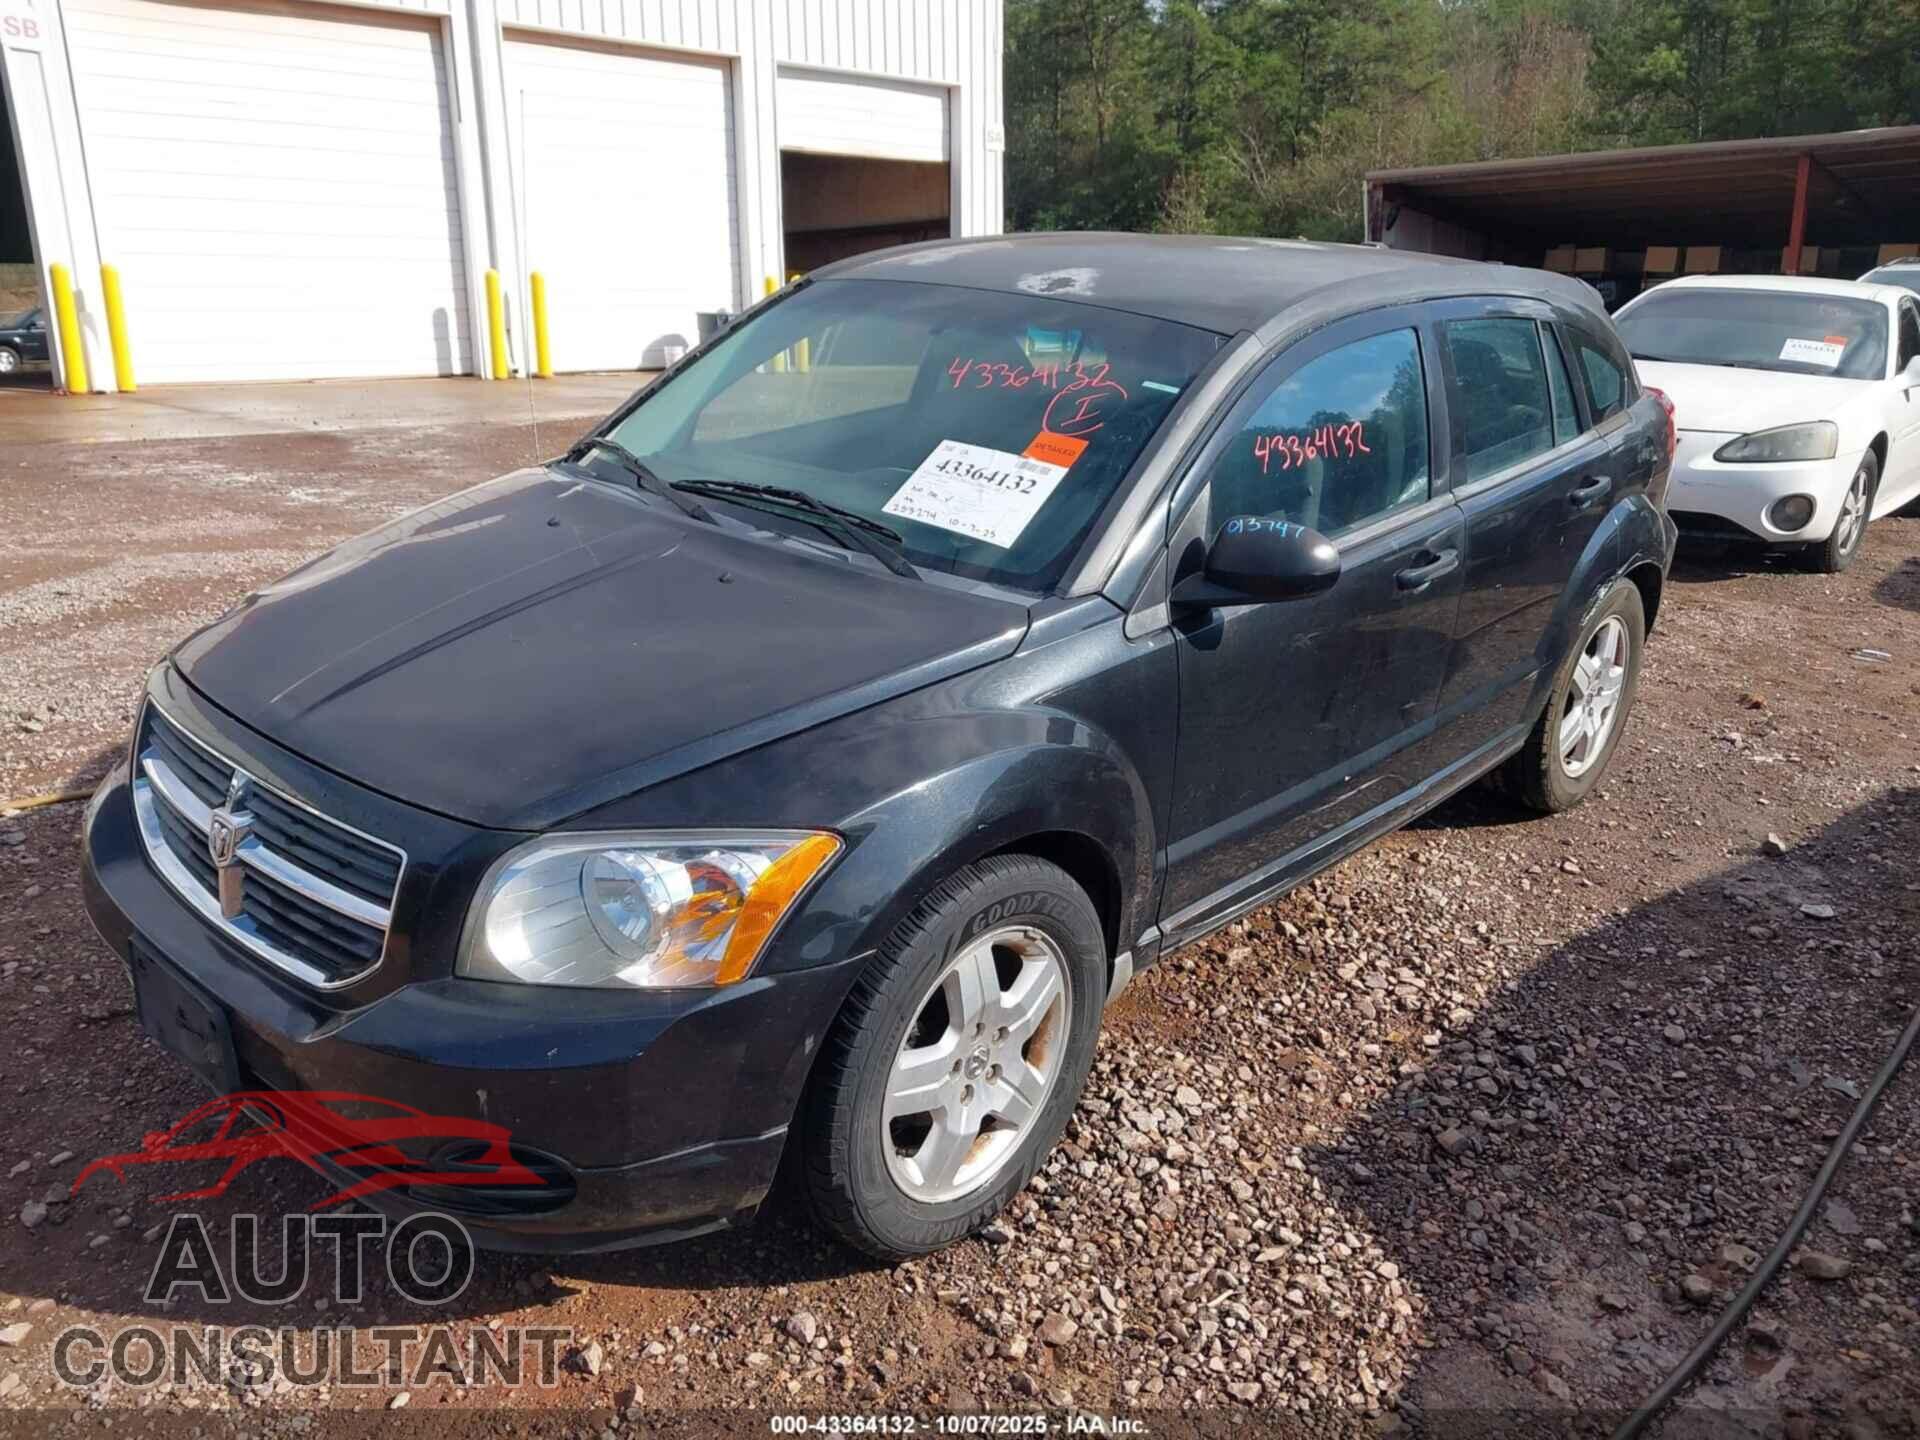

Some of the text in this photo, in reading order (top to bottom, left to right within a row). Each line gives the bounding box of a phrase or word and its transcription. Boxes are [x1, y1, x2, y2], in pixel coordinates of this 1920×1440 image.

[948, 357, 1113, 390] 43364132
[1254, 421, 1371, 474] 43364132
[936, 459, 1038, 495] 43364132
